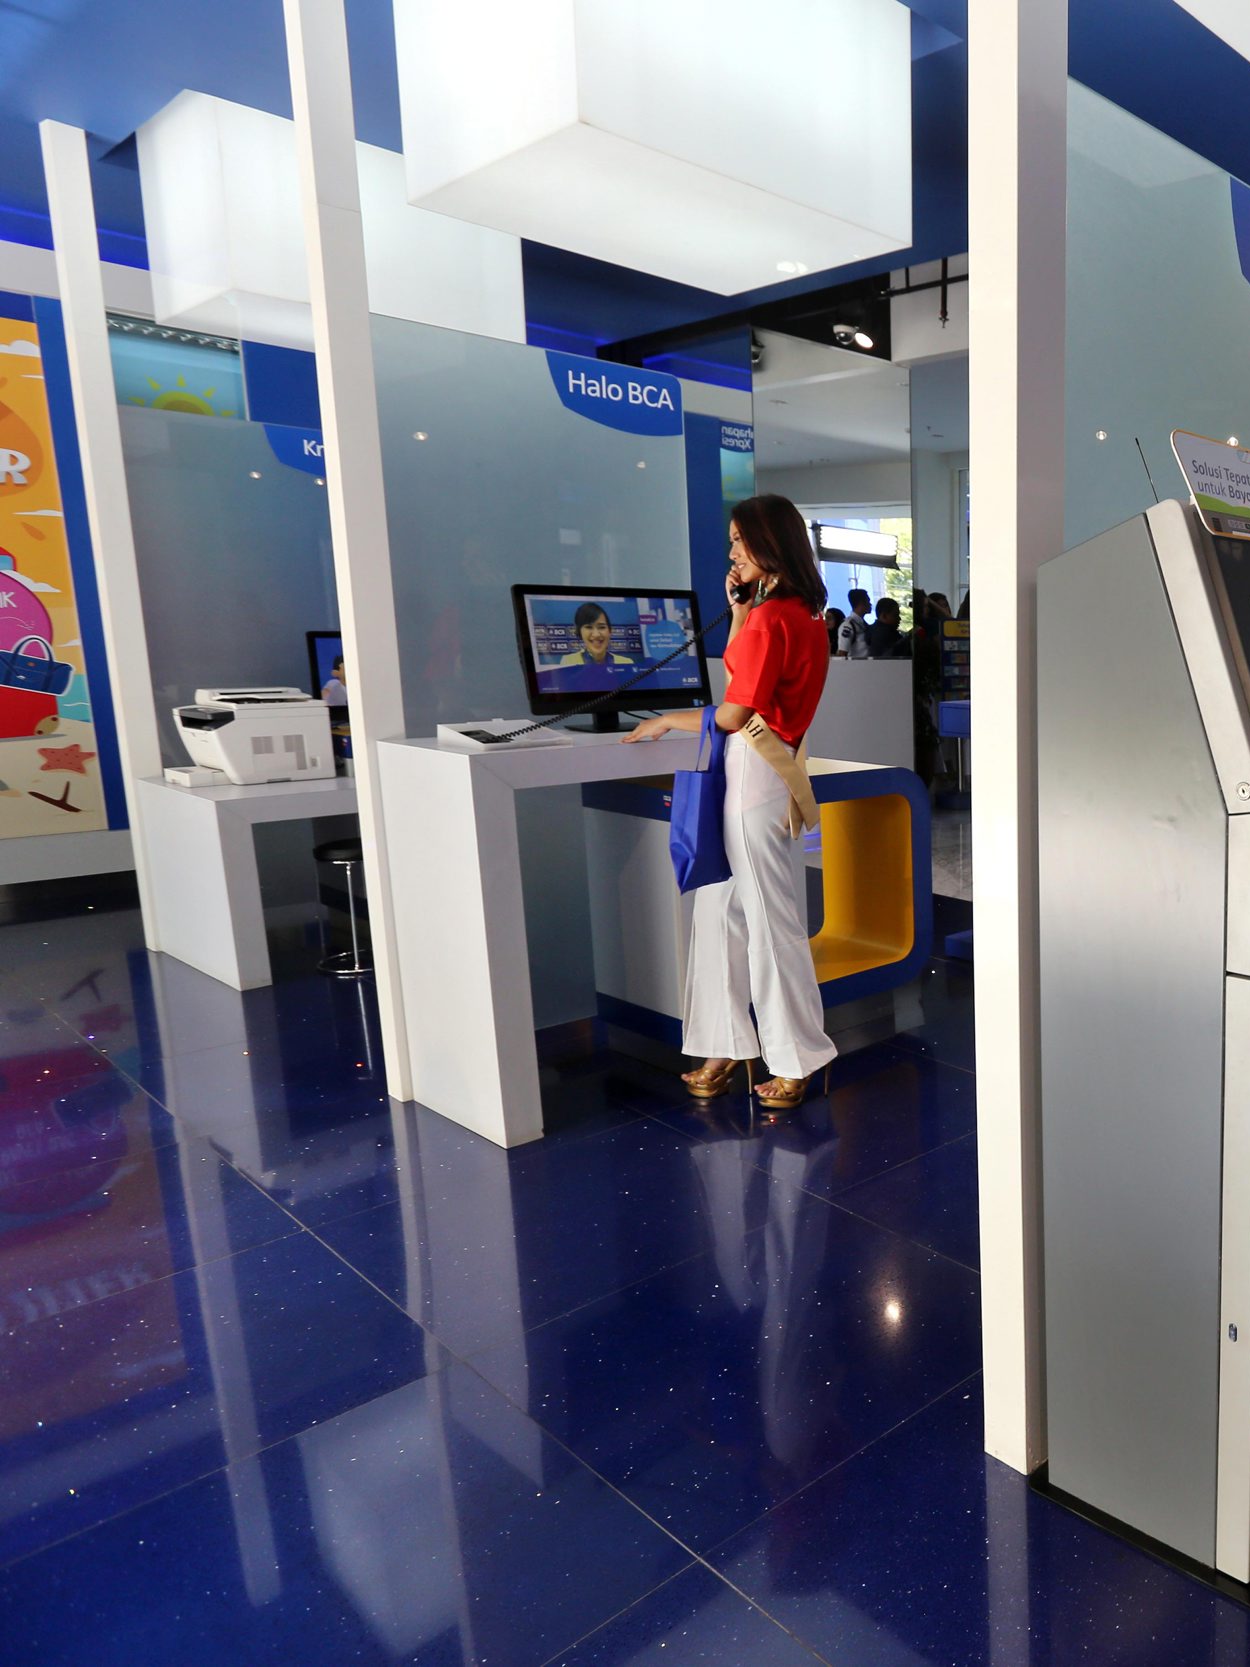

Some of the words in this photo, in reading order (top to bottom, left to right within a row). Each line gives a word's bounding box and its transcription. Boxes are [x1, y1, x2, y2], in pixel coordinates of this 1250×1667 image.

[567, 370, 623, 401] Halo
[627, 381, 675, 411] BCA
[1192, 459, 1222, 479] Solusi
[1223, 468, 1250, 487] Tepat
[1197, 481, 1227, 497] untuk
